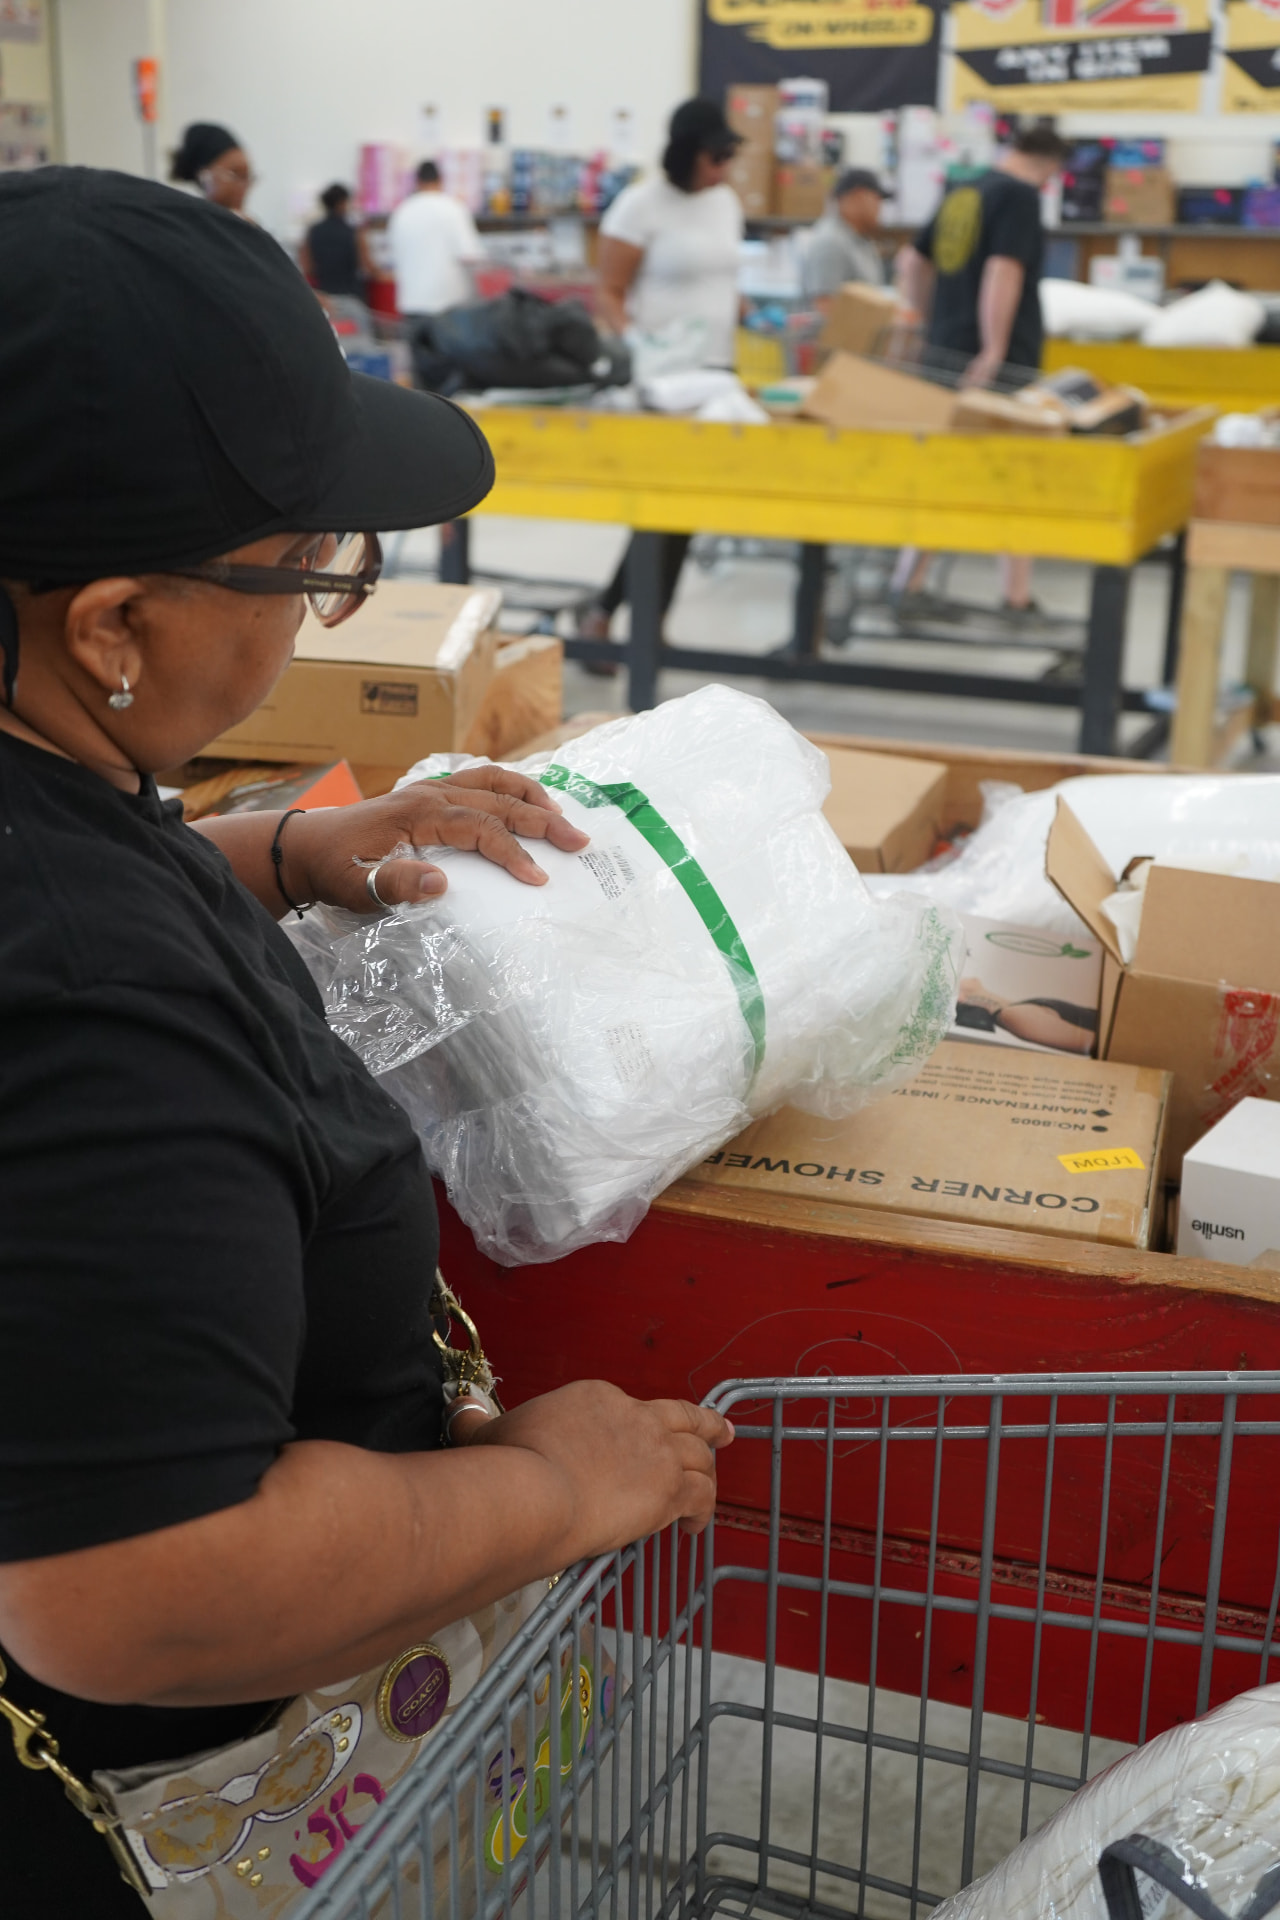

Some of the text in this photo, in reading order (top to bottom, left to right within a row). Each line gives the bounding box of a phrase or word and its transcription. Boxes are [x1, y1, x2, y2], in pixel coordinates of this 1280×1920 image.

[954, 1094, 1088, 1116] MAINTENANCE
[910, 1175, 1100, 1213] CORNER
[1191, 1219, 1245, 1241] usmile
[403, 1675, 440, 1717] COACH
